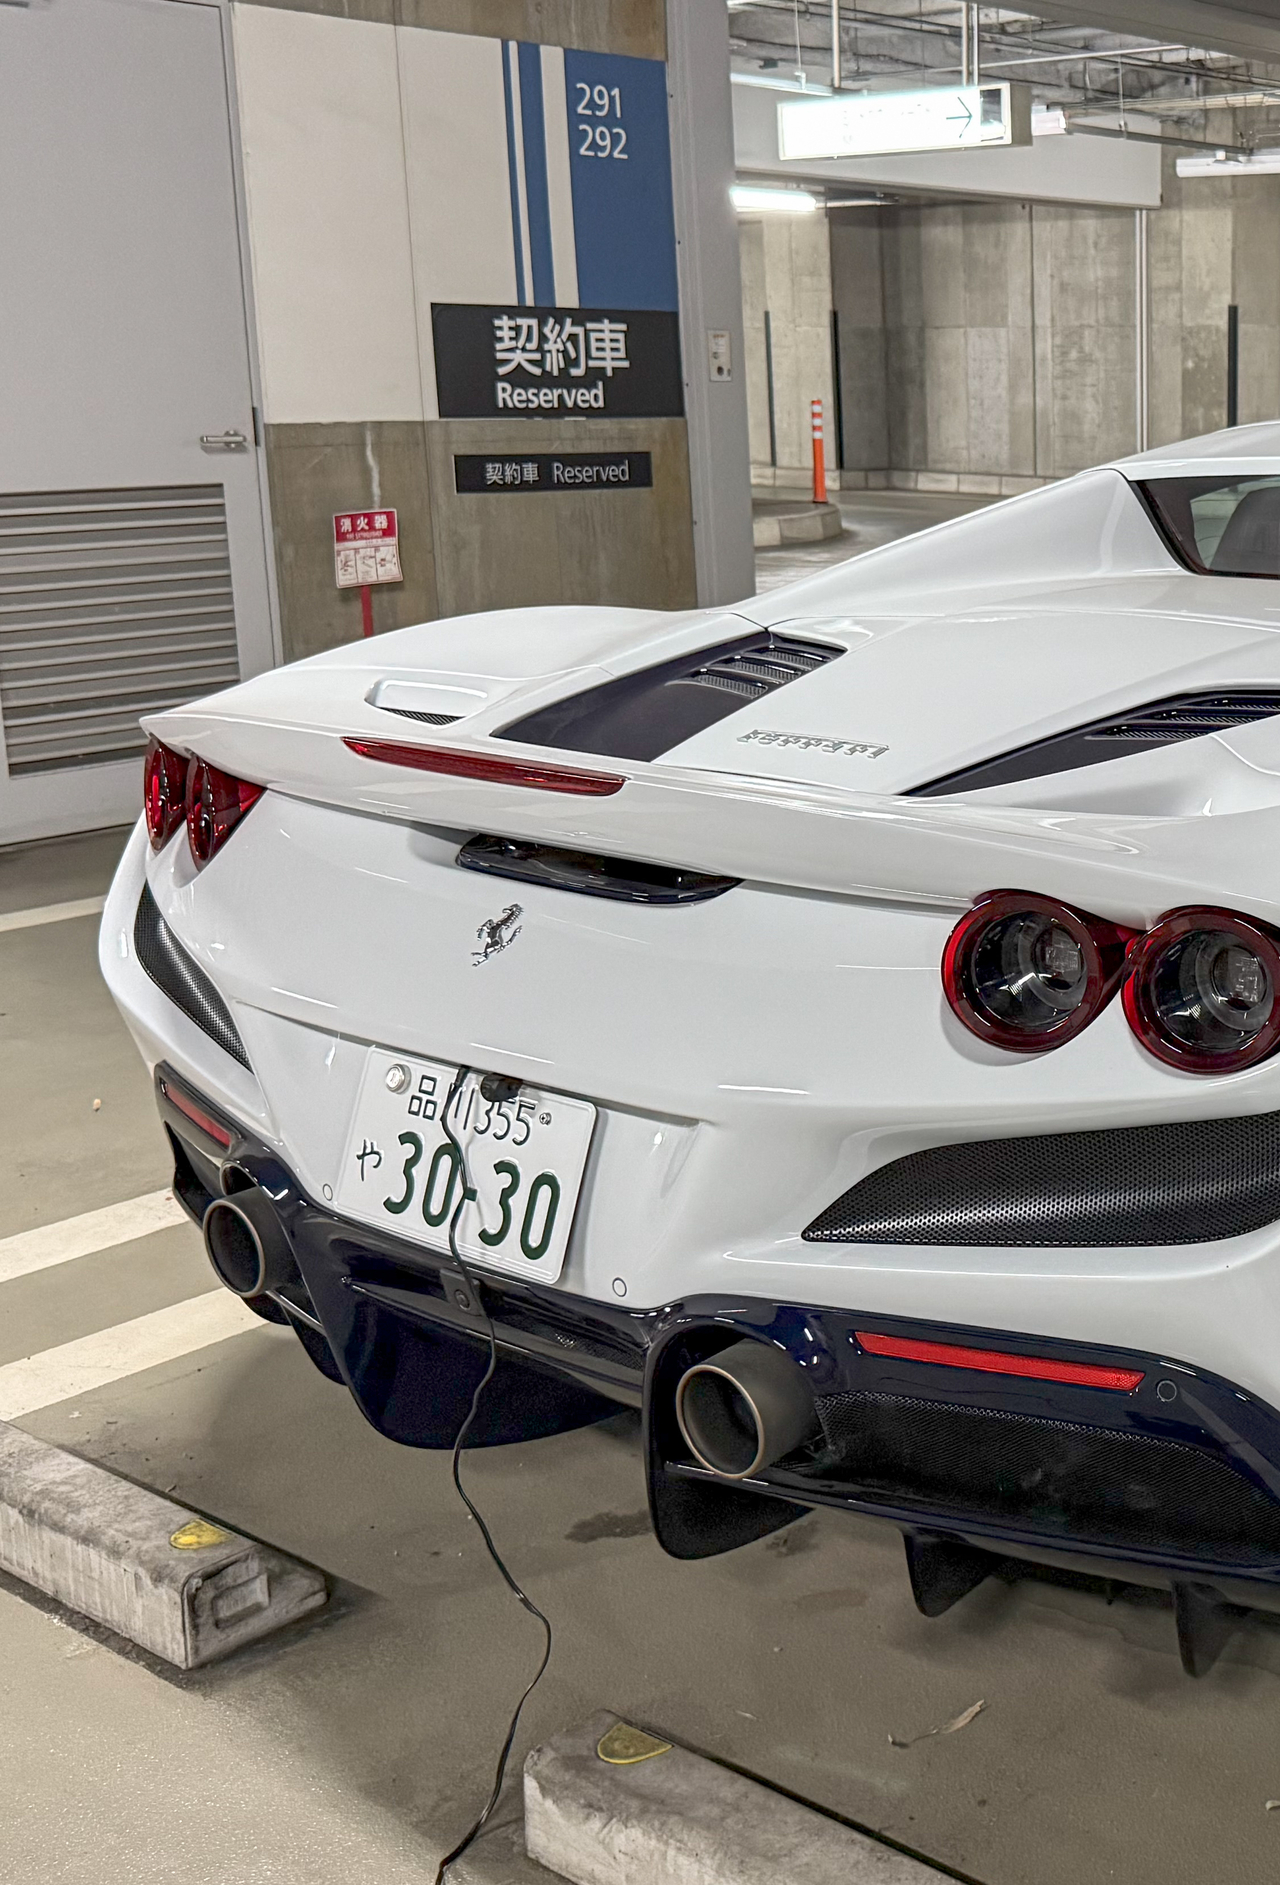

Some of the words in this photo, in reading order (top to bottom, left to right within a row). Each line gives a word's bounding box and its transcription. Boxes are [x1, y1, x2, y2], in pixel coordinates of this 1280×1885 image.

[576, 83, 621, 118] 291
[579, 124, 628, 159] 292
[493, 315, 630, 377] 契約車
[497, 381, 605, 409] Reserved
[485, 462, 540, 485] 契約車
[553, 460, 630, 484] Reserved
[473, 1096, 536, 1147] 355
[355, 1138, 384, 1182] や
